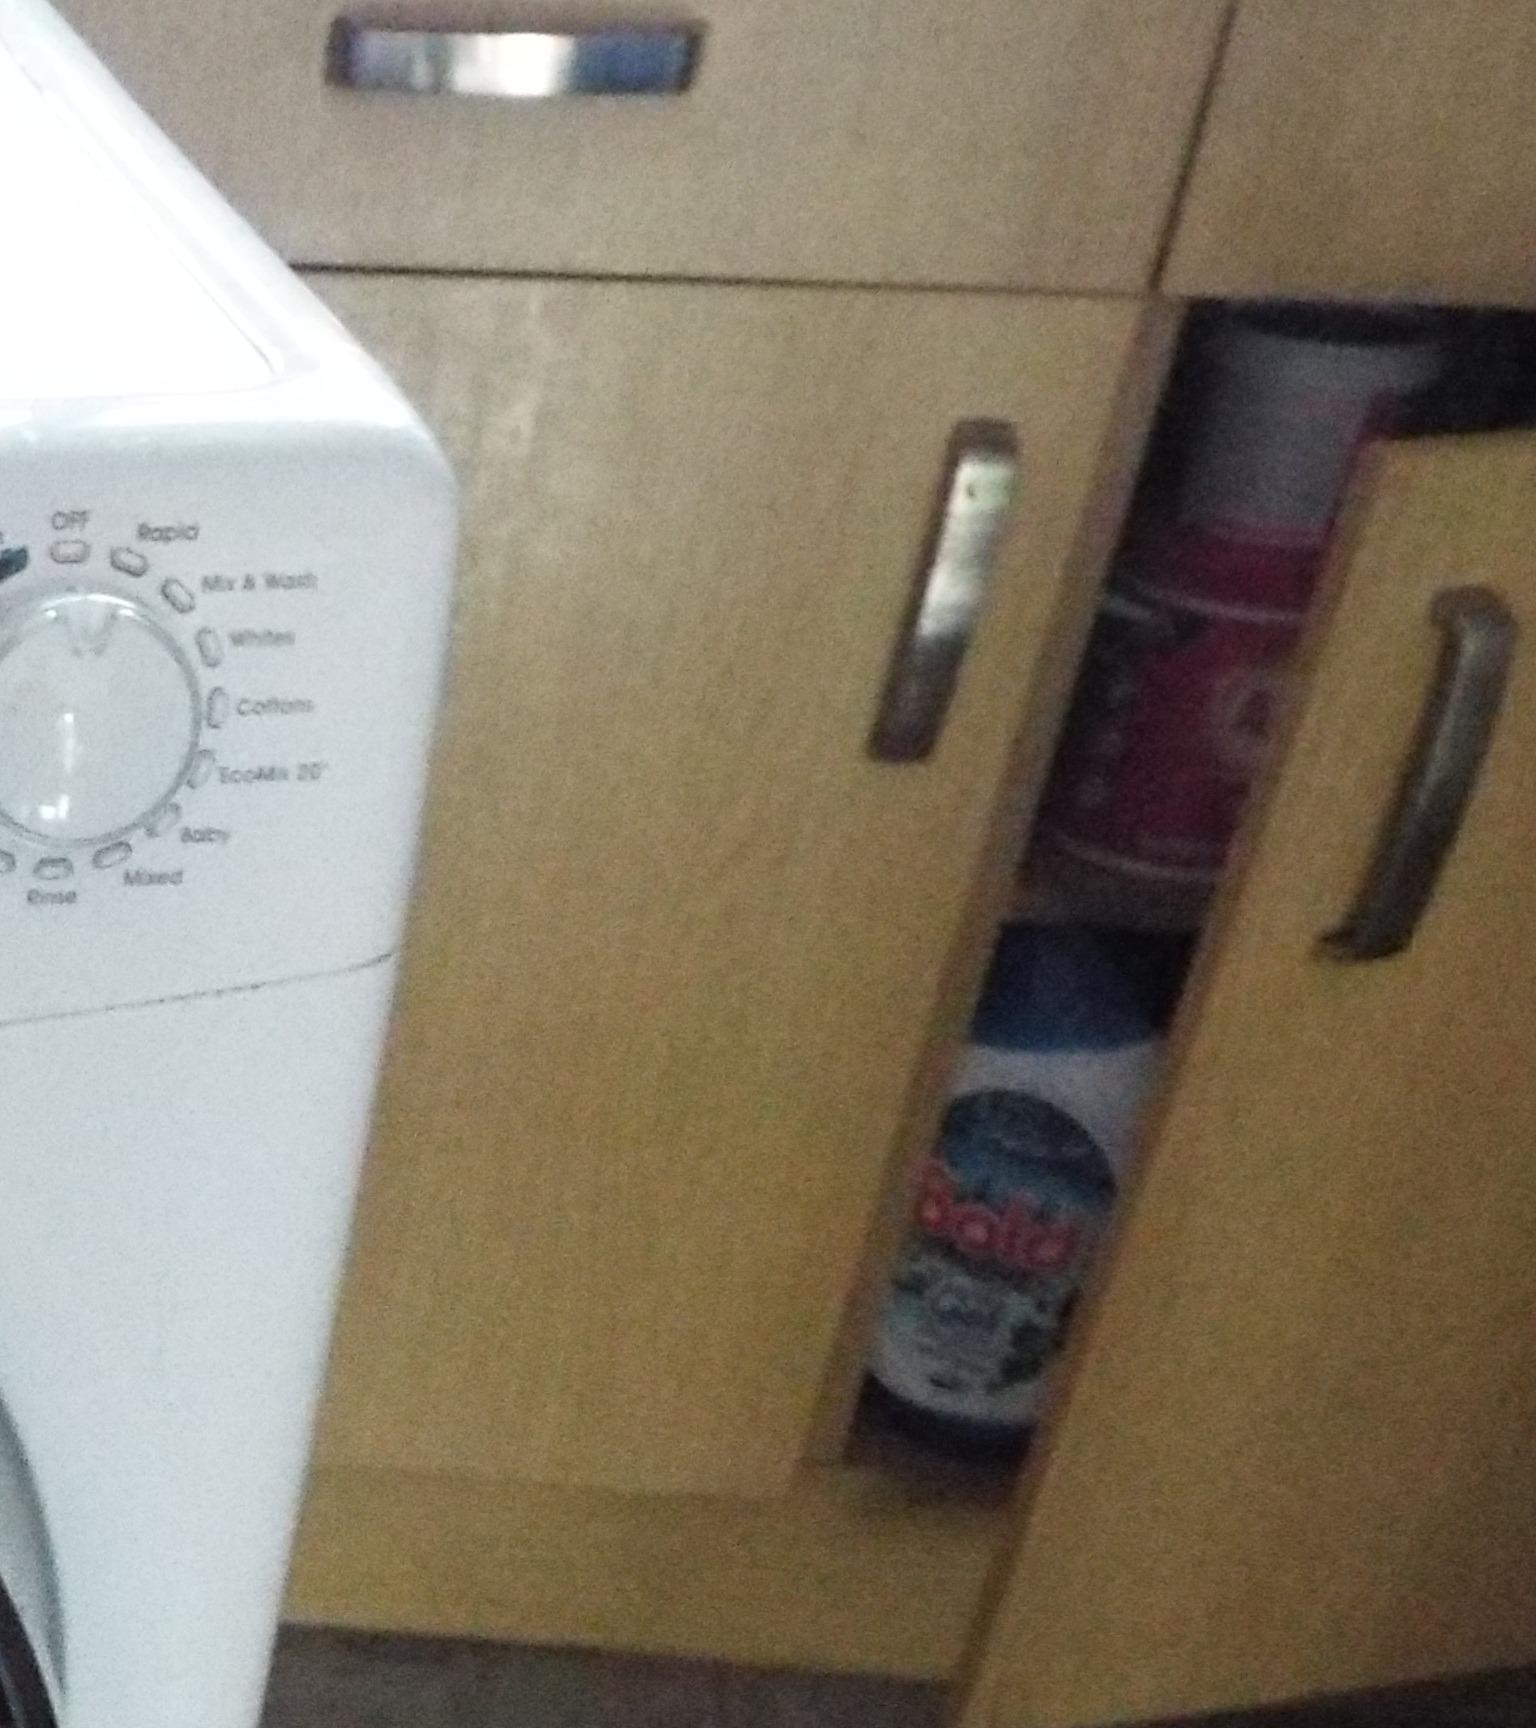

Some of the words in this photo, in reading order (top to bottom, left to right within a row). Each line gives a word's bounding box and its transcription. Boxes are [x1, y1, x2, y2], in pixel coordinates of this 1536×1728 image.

[137, 523, 200, 543] Rapid
[200, 573, 235, 592] Mix
[264, 572, 317, 590] Wash
[230, 628, 297, 648] Whites
[236, 698, 316, 718] Cottons
[180, 826, 231, 845] Baby
[123, 868, 184, 887] Mixed
[26, 887, 78, 904] Rinse
